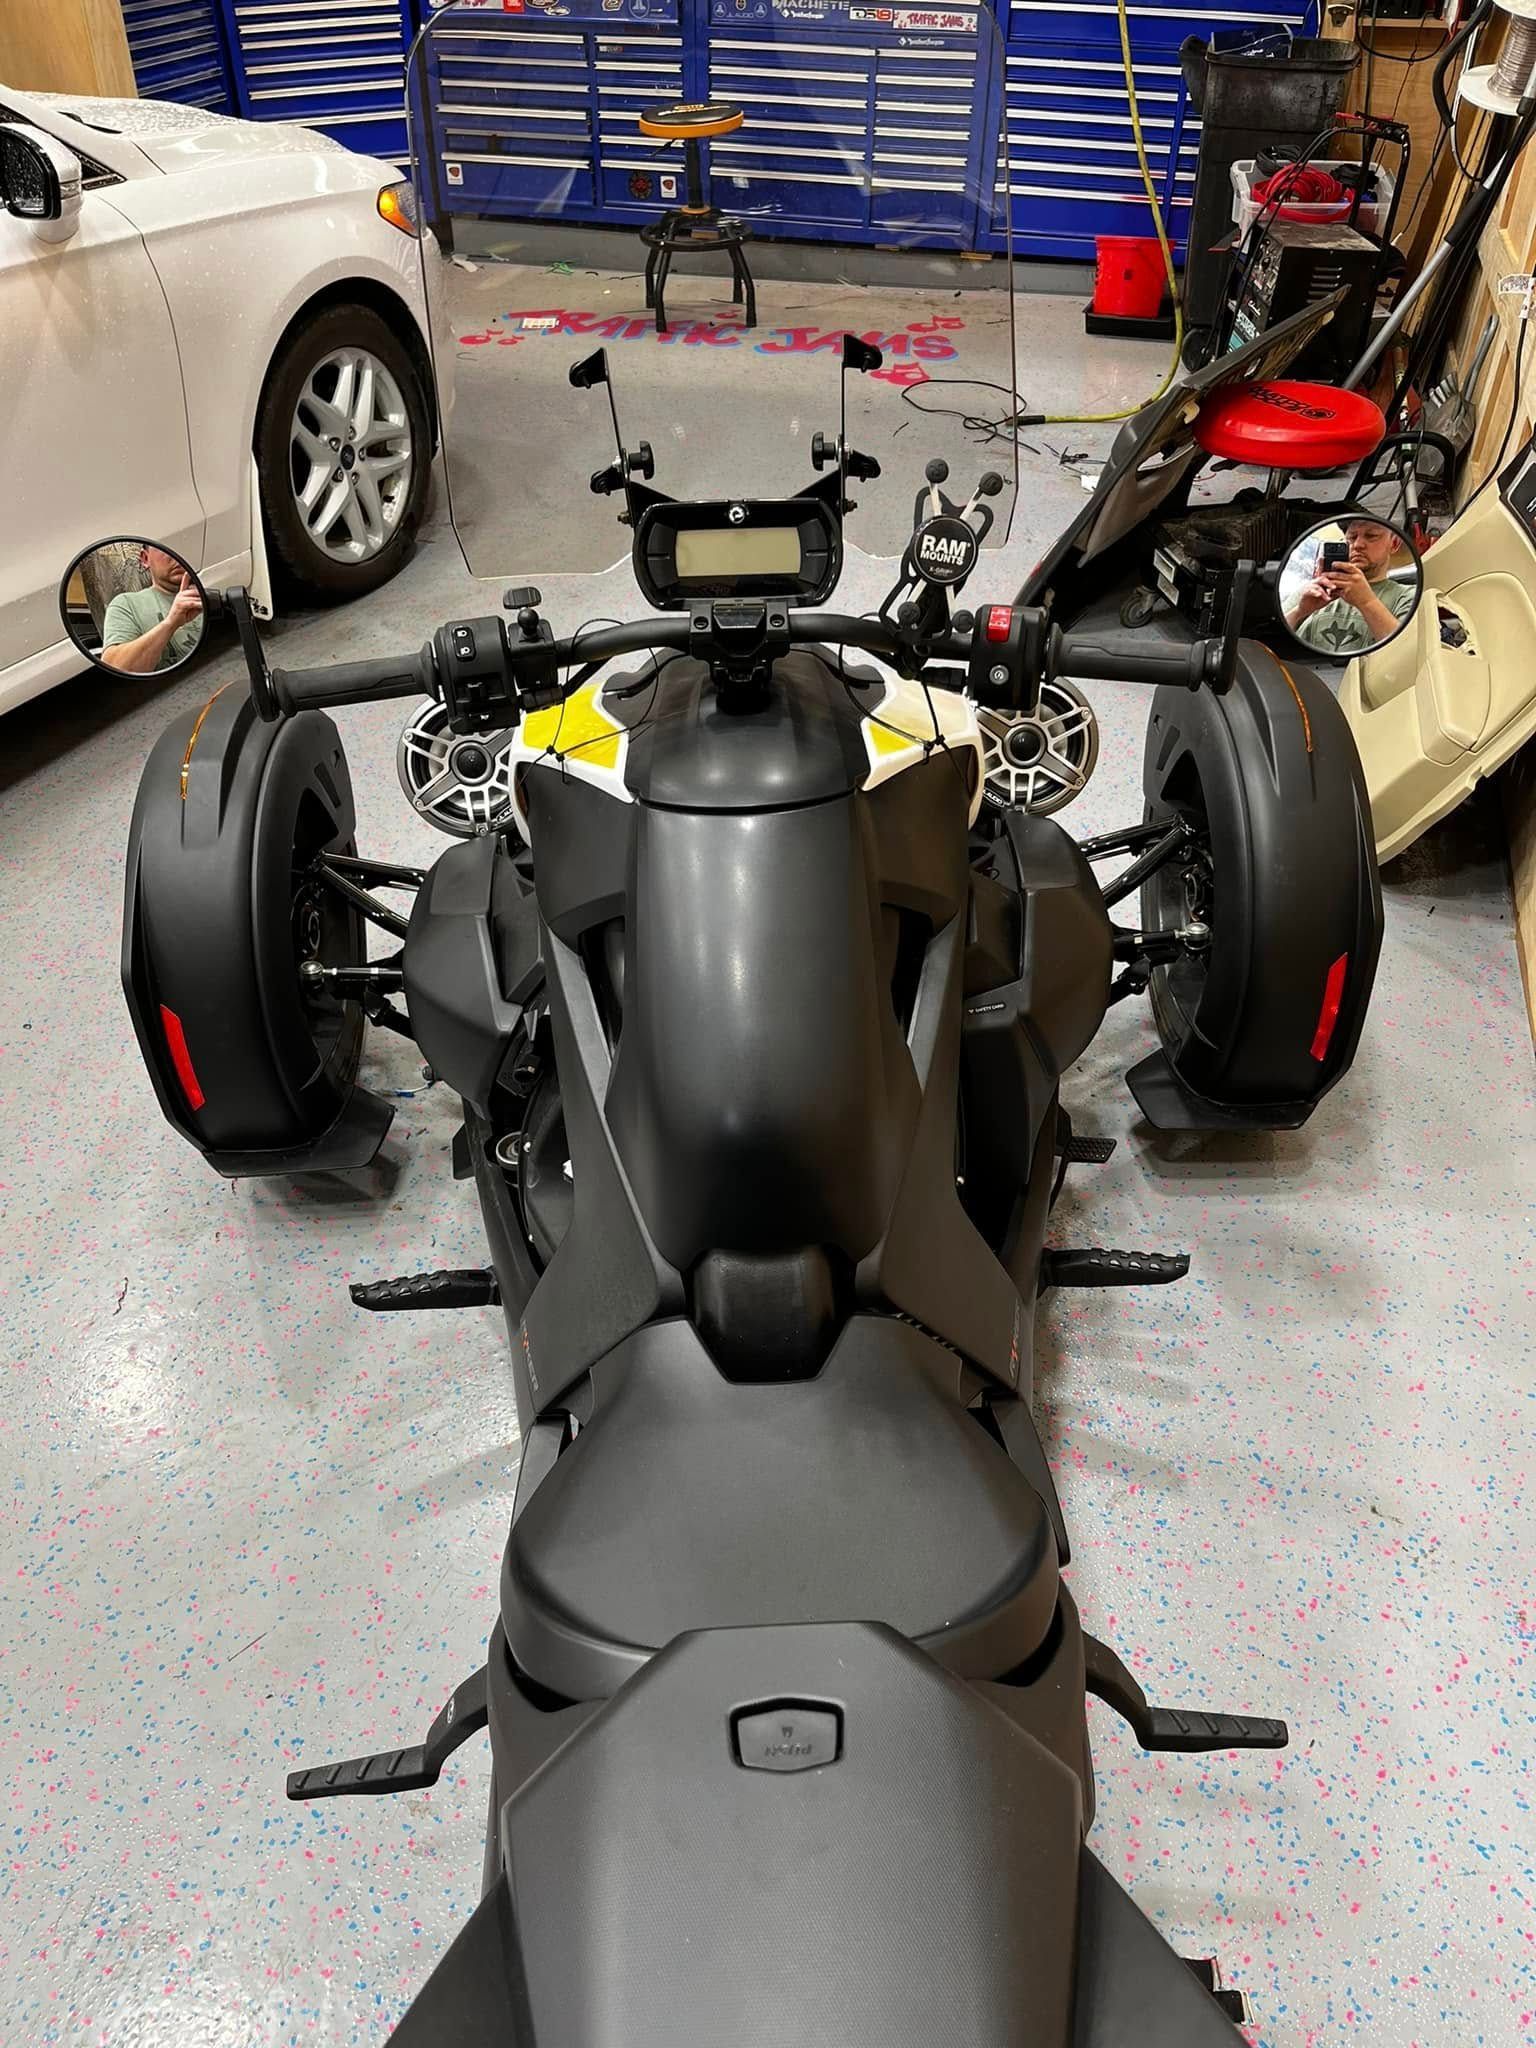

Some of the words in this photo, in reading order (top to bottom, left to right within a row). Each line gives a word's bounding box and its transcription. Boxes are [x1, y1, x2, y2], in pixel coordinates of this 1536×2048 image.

[502, 309, 752, 348] TRAFFIC
[754, 327, 959, 361] JAMS
[921, 534, 967, 558] RAM
[920, 551, 965, 566] MOUNTS
